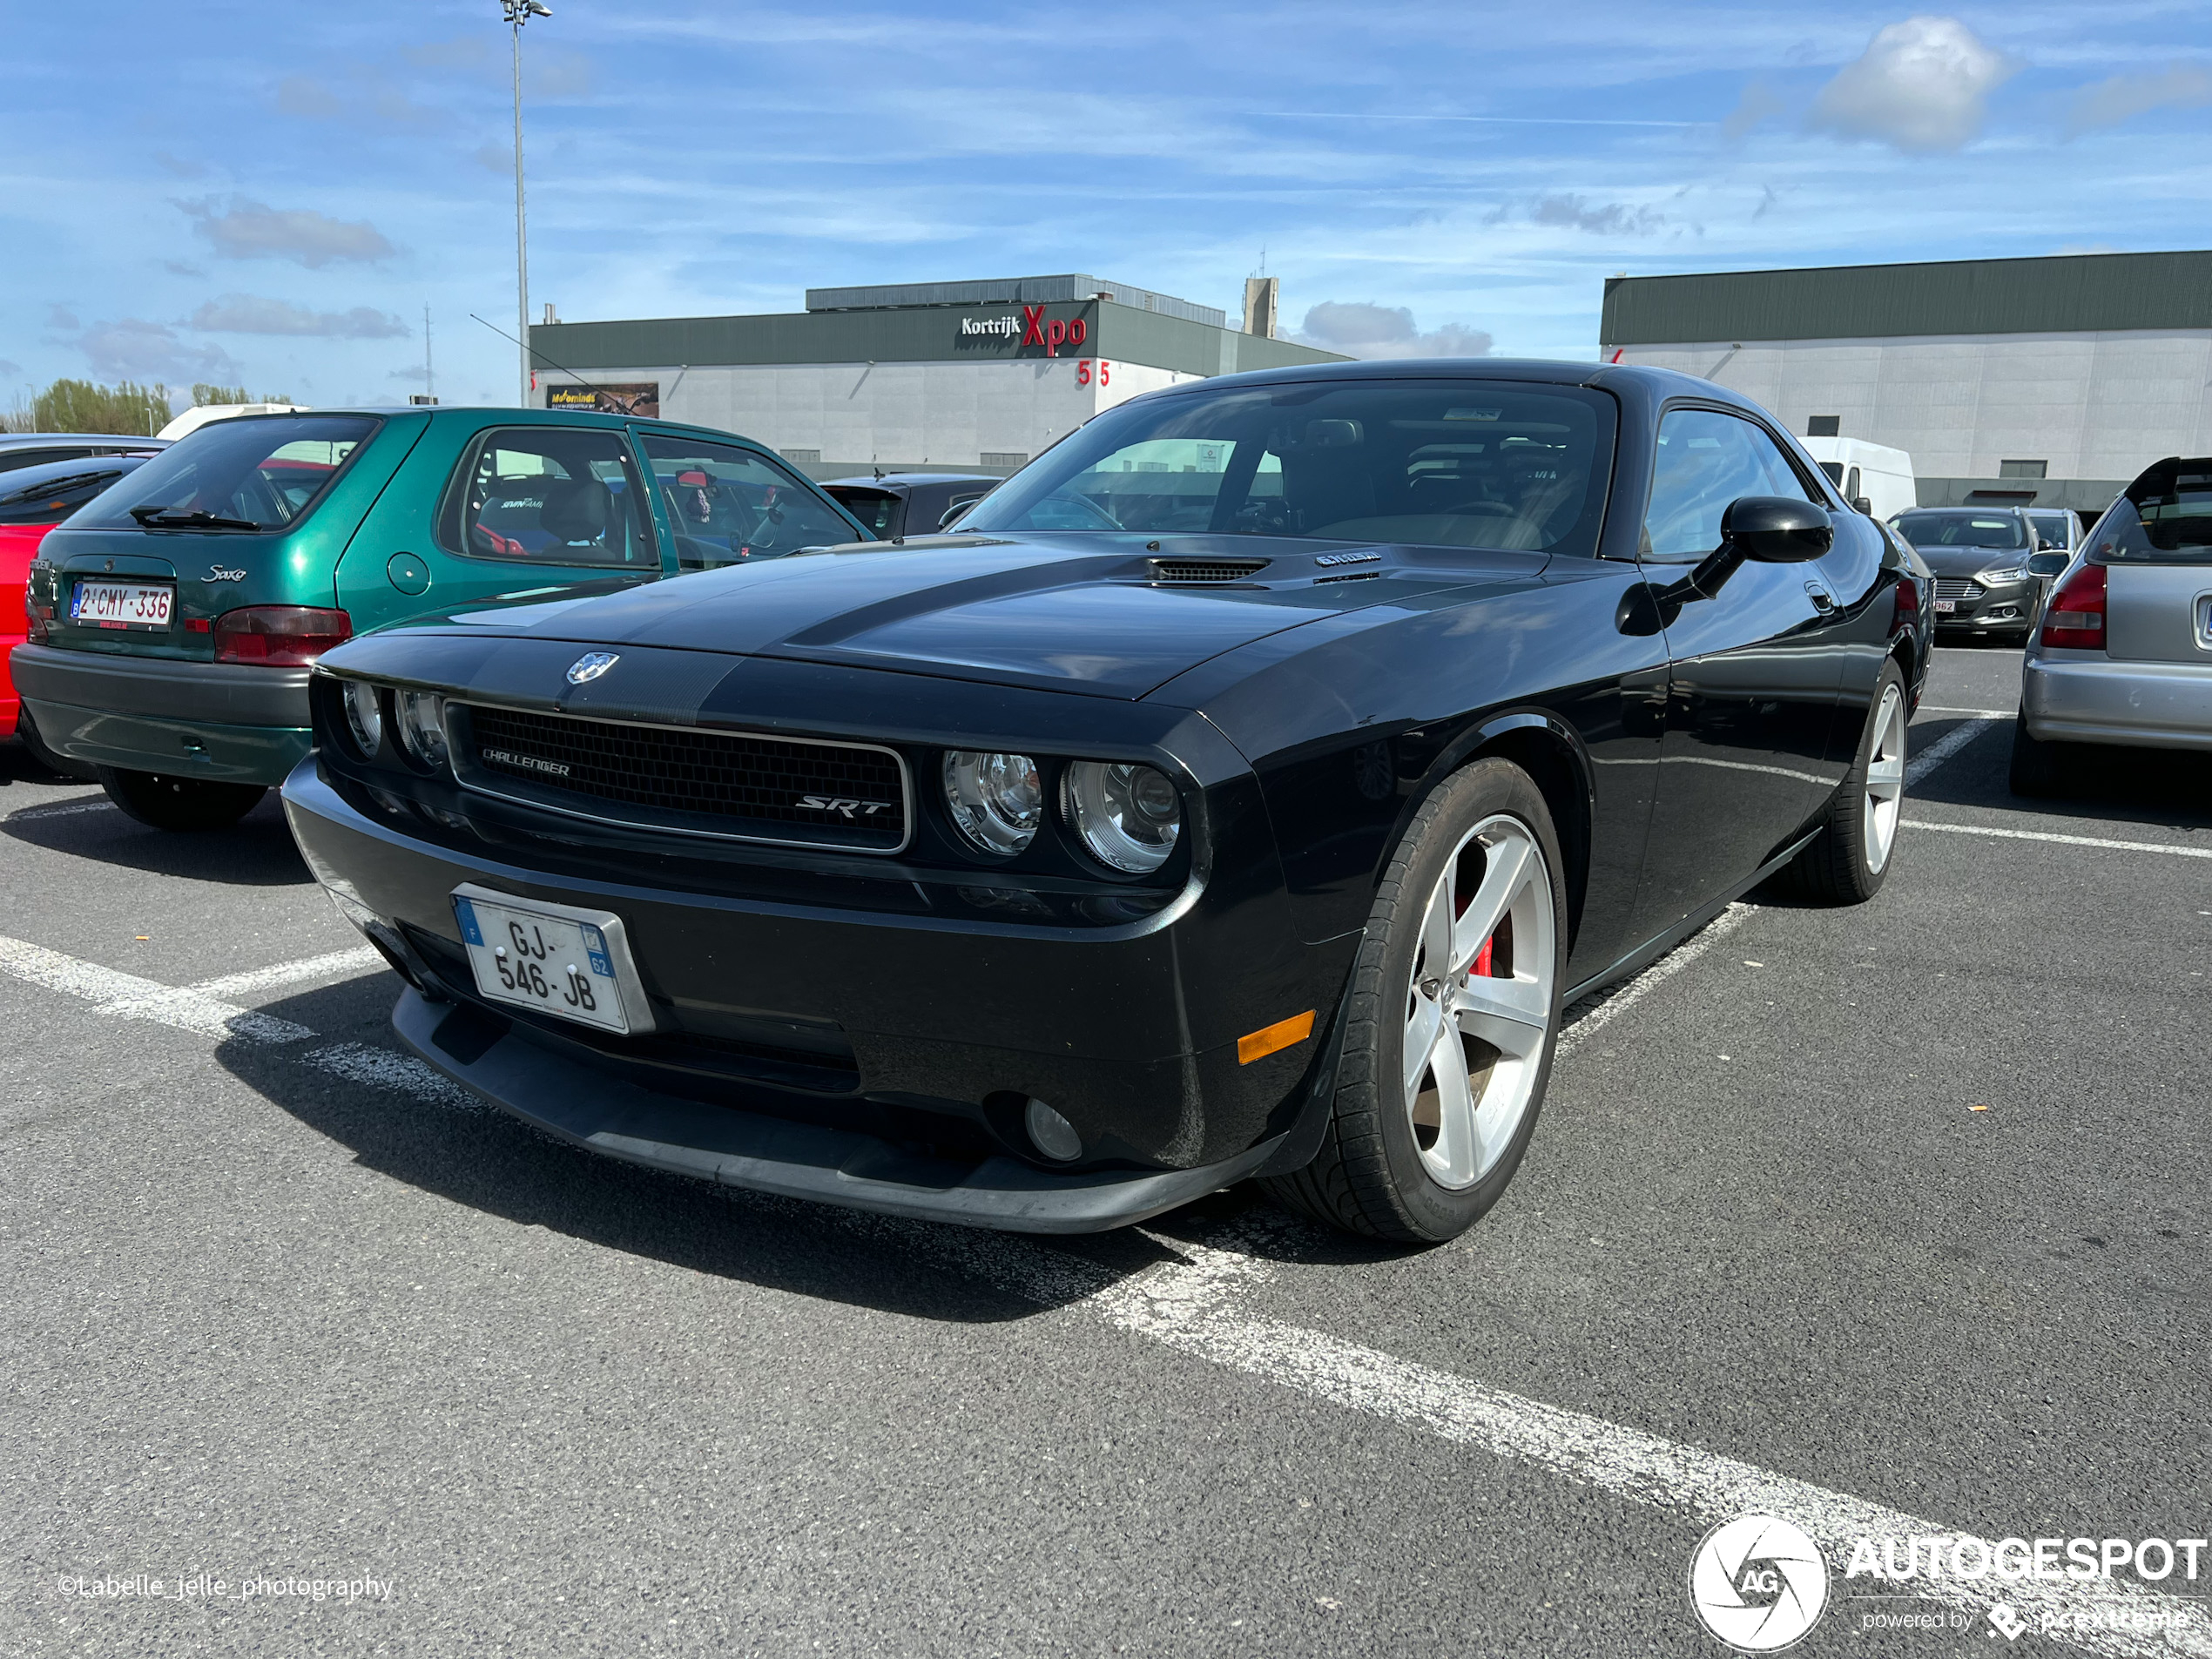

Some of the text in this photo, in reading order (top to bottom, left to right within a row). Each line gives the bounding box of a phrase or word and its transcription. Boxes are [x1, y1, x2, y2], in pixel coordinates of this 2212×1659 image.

[961, 305, 1087, 358] Kortrijk Xpo
[1078, 360, 1091, 385] 5
[1100, 361, 1109, 387] 5
[201, 564, 247, 582] Saxo
[72, 604, 79, 616] B
[482, 748, 570, 777] CHALLENGER
[795, 796, 892, 818] SRT
[469, 927, 476, 939] F
[591, 958, 609, 974] 62
